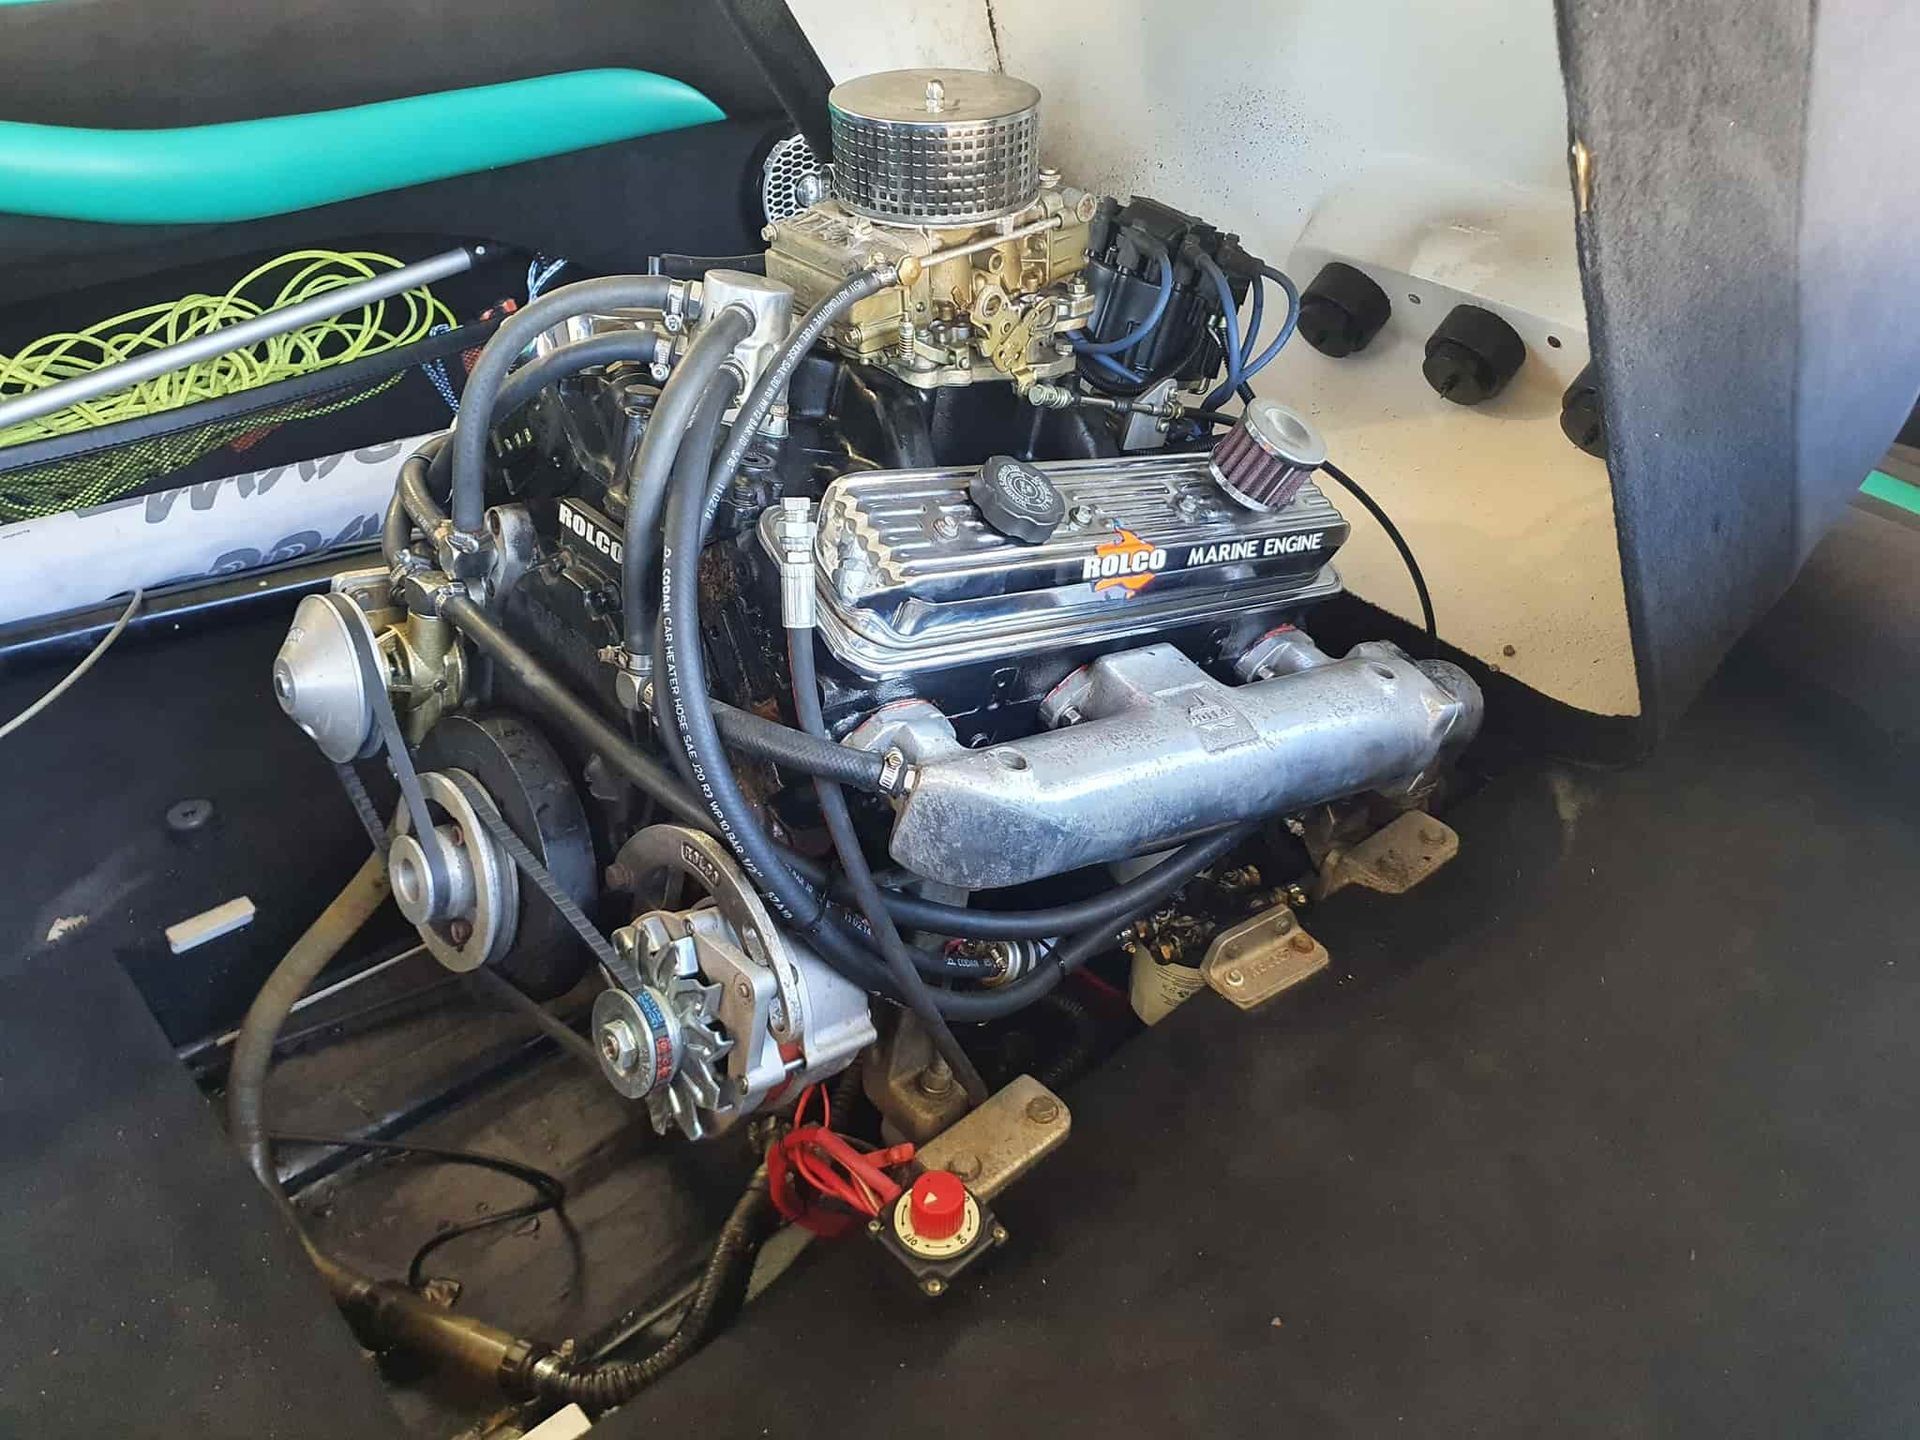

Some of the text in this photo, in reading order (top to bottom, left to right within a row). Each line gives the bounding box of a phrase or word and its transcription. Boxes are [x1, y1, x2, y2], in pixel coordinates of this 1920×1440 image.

[799, 324, 815, 342] FUEL
[559, 503, 623, 565] ROLCO
[1082, 533, 1323, 580] ROLCO MARINE ENGINE
[662, 568, 671, 613] CODAN
[663, 617, 673, 642] CAR
[665, 645, 680, 695] HEATER
[674, 698, 689, 732] HOSE
[683, 734, 698, 760] SAE
[692, 762, 706, 781] J20
[709, 801, 724, 819] WP
[719, 820, 730, 831] 10
[725, 832, 744, 853] BAR
